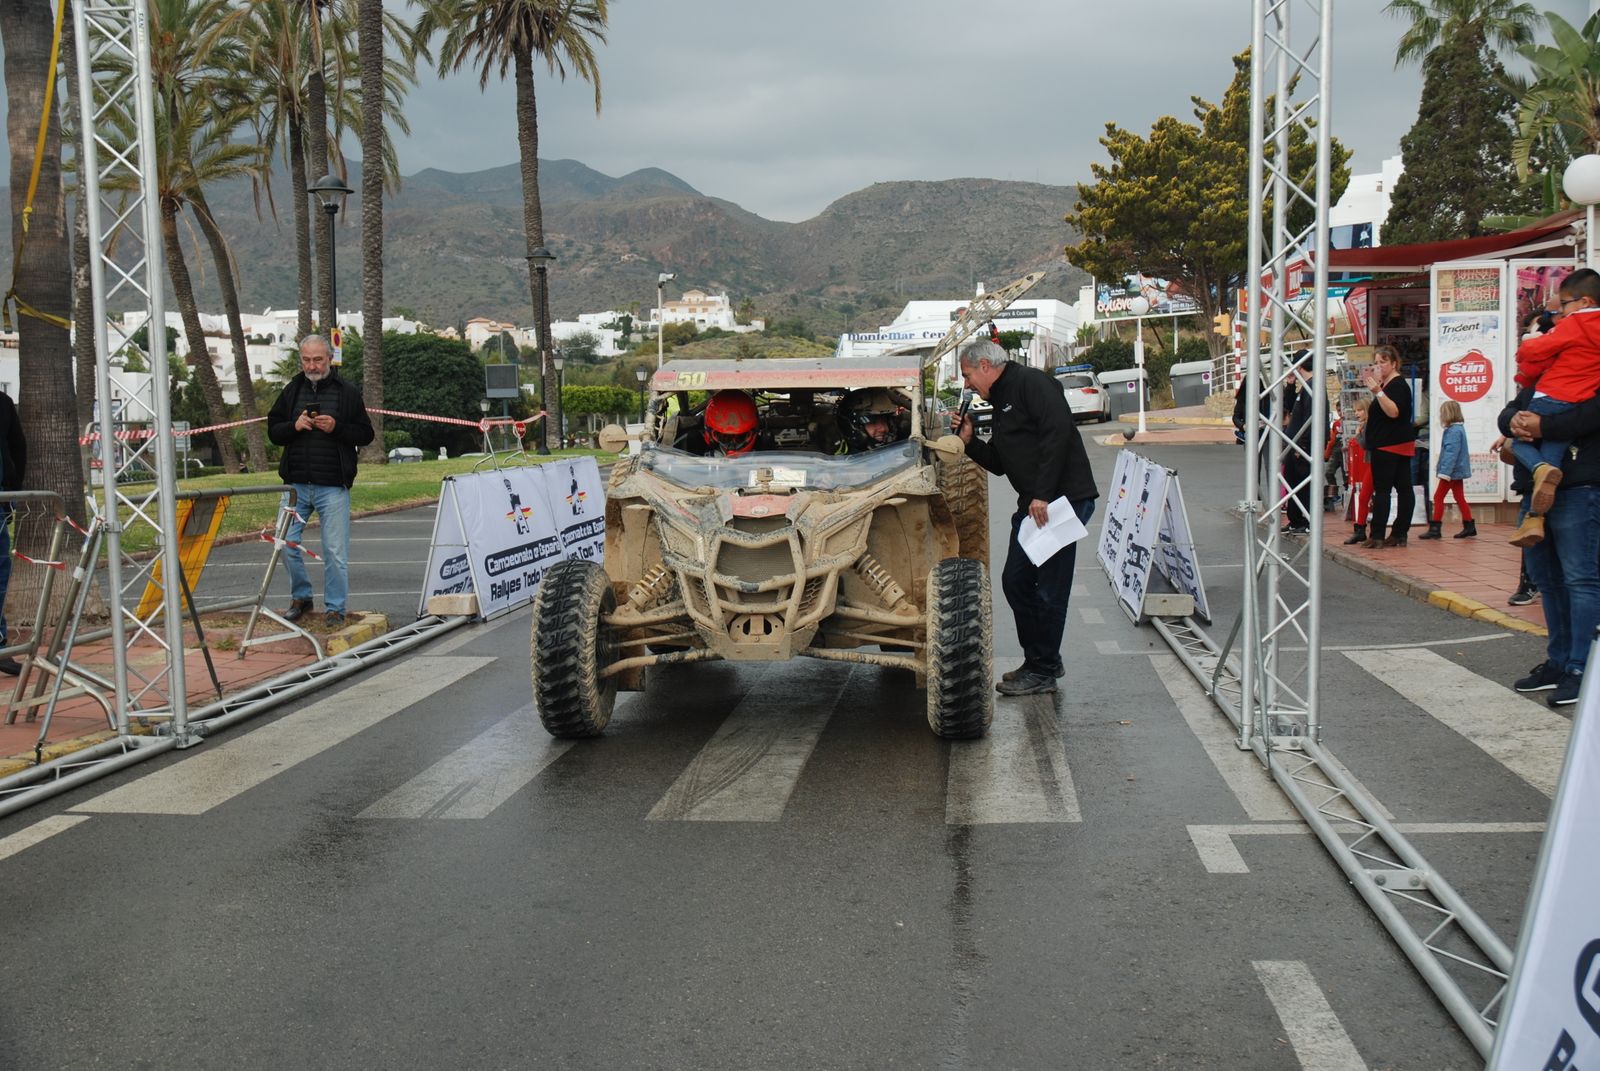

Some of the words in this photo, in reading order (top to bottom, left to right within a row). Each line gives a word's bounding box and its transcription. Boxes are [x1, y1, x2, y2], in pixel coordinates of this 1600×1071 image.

[1441, 322, 1480, 335] Trident
[678, 371, 706, 387] 50
[1446, 376, 1462, 385] ON
[1465, 376, 1487, 384] SALE
[1455, 384, 1479, 393] HERE
[490, 577, 521, 601] Rallyes
